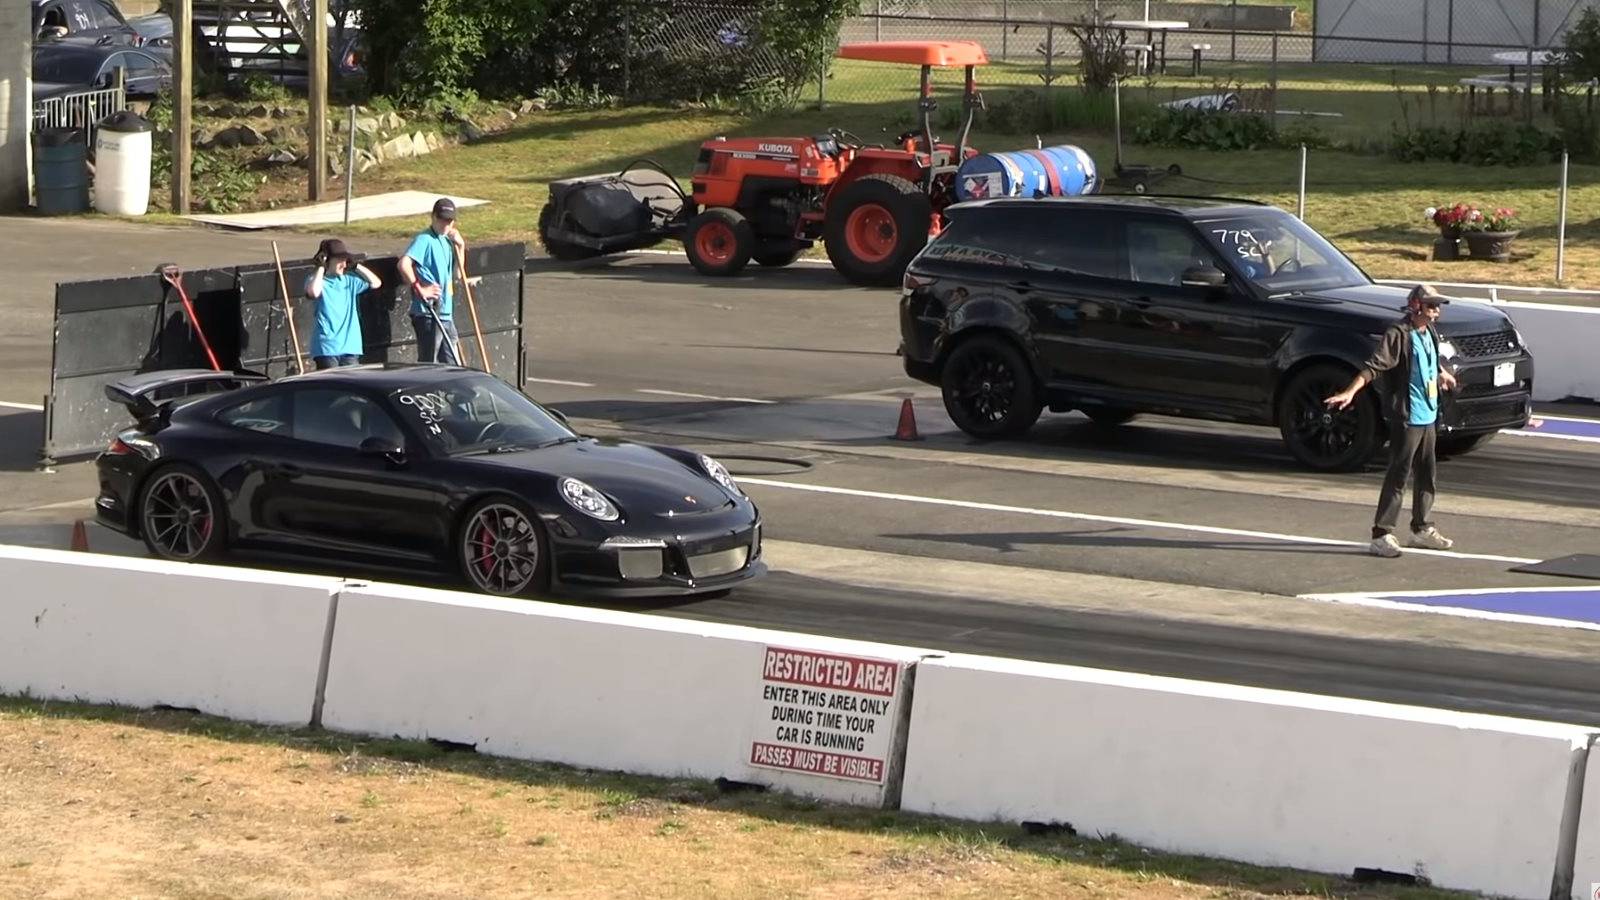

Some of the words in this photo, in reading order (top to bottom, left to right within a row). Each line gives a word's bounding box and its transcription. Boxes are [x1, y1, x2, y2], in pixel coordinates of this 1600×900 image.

[758, 143, 793, 153] KUBOTA
[1212, 229, 1258, 244] 779
[764, 651, 852, 687] RESTRICTED
[853, 663, 893, 693] AREA
[763, 685, 799, 704] ENTER
[801, 690, 826, 708] THIS
[828, 694, 857, 712] AREA
[860, 698, 890, 716] ONLY
[772, 706, 813, 725] DURING
[816, 712, 842, 729] TIME
[845, 716, 875, 734] YOUR
[776, 726, 801, 743] CAR
[801, 729, 811, 744] IS
[814, 731, 864, 752] RUNNING
[754, 745, 792, 766] PASSES
[793, 750, 824, 770] MUST
[824, 755, 838, 773] BE
[840, 758, 879, 779] VISIBLE
